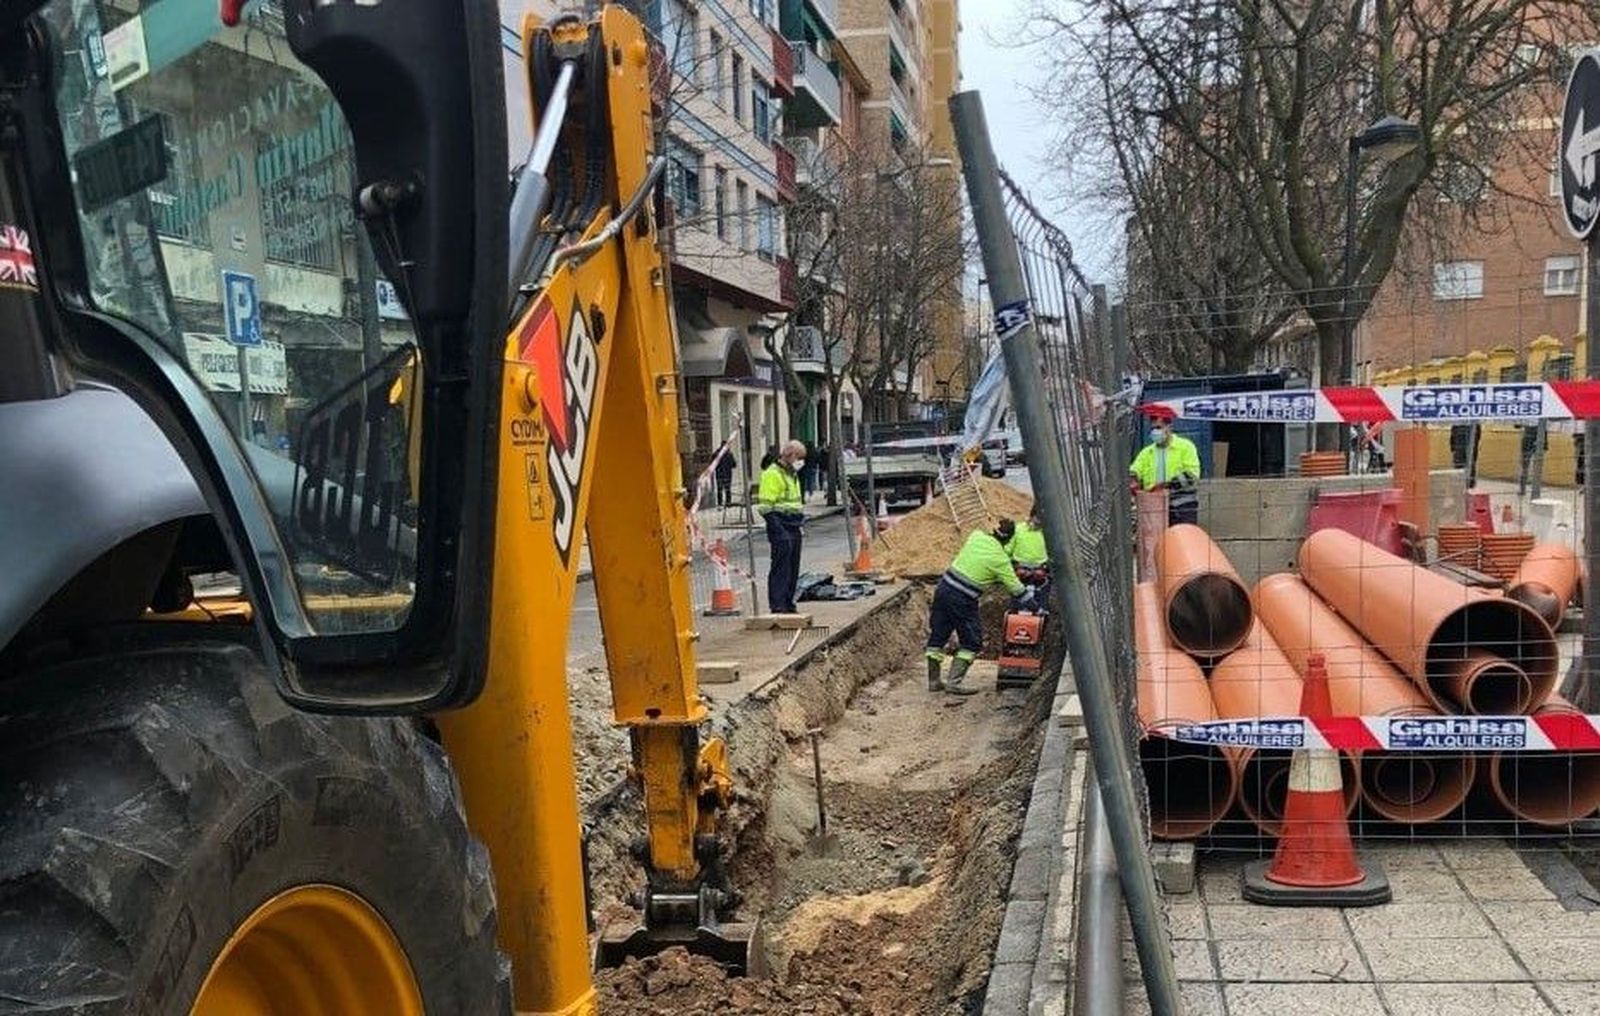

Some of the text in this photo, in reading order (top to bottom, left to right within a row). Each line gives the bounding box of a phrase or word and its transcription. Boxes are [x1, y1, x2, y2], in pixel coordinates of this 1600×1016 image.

[231, 281, 253, 337] P
[1404, 386, 1542, 406] Gahlsa
[1217, 406, 1314, 419] ALQUILERES
[1437, 403, 1540, 418] ALQUILERES
[548, 310, 598, 551] JCB
[1391, 719, 1525, 736] Gahlsa
[1208, 735, 1303, 747] ALQUILERES
[1423, 735, 1525, 748] ALQUILERES
